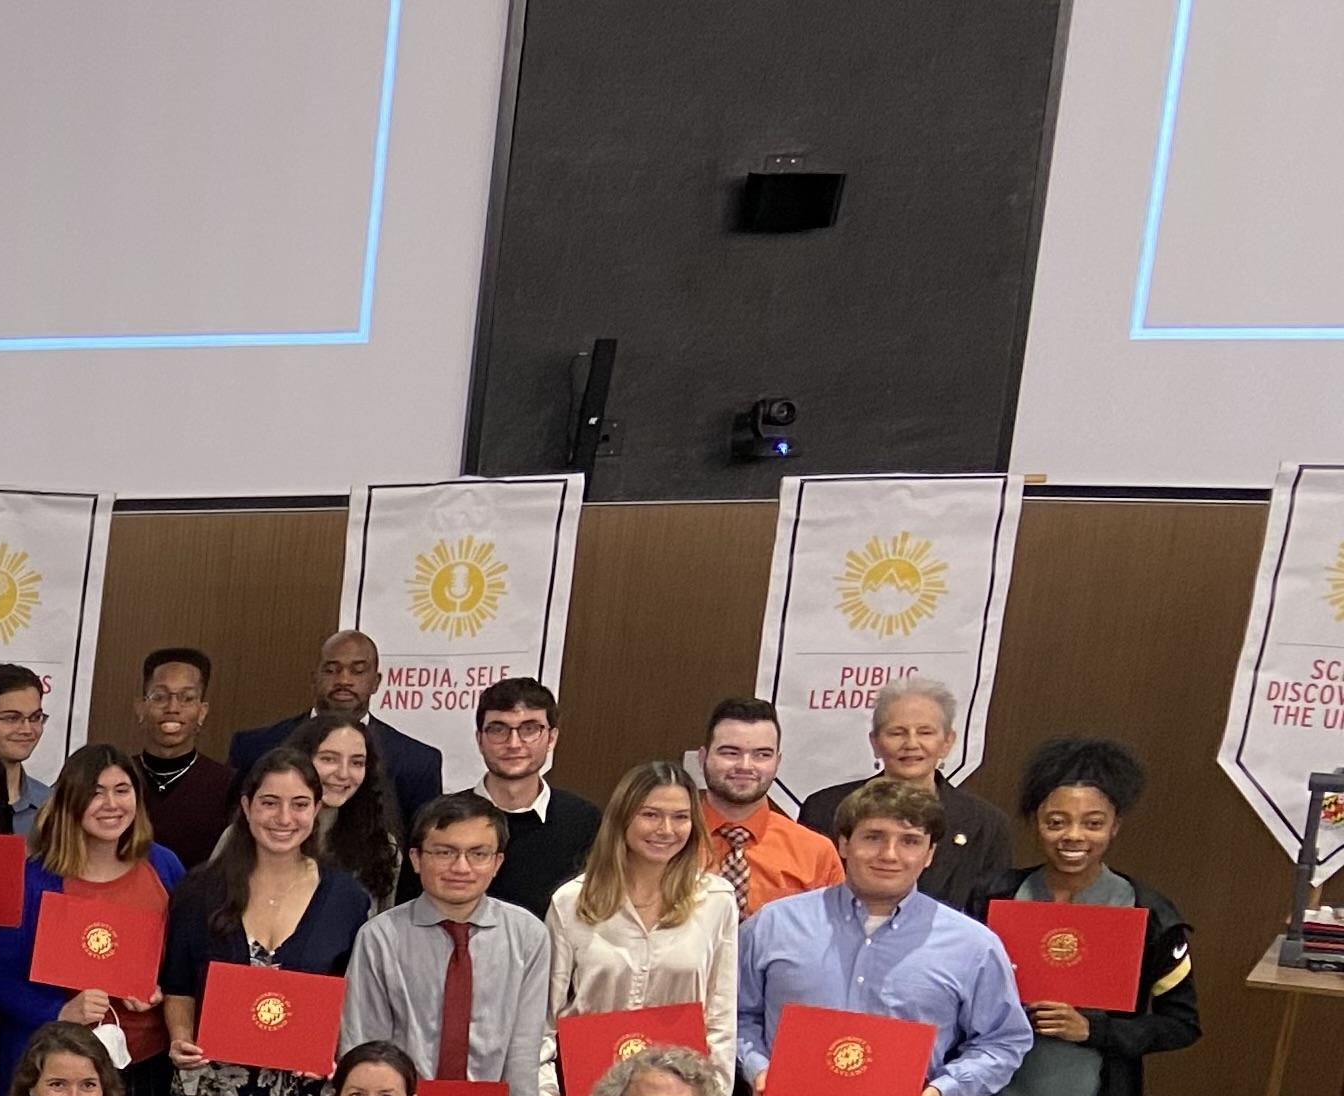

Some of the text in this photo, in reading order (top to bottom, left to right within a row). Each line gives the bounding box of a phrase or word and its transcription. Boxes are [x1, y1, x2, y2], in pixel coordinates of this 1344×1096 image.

[387, 667, 459, 689] MEDIA,
[379, 689, 477, 711] AND SOCI
[808, 689, 878, 710] LEADE
[1266, 681, 1344, 705] DISCO
[1272, 704, 1316, 728] THE
